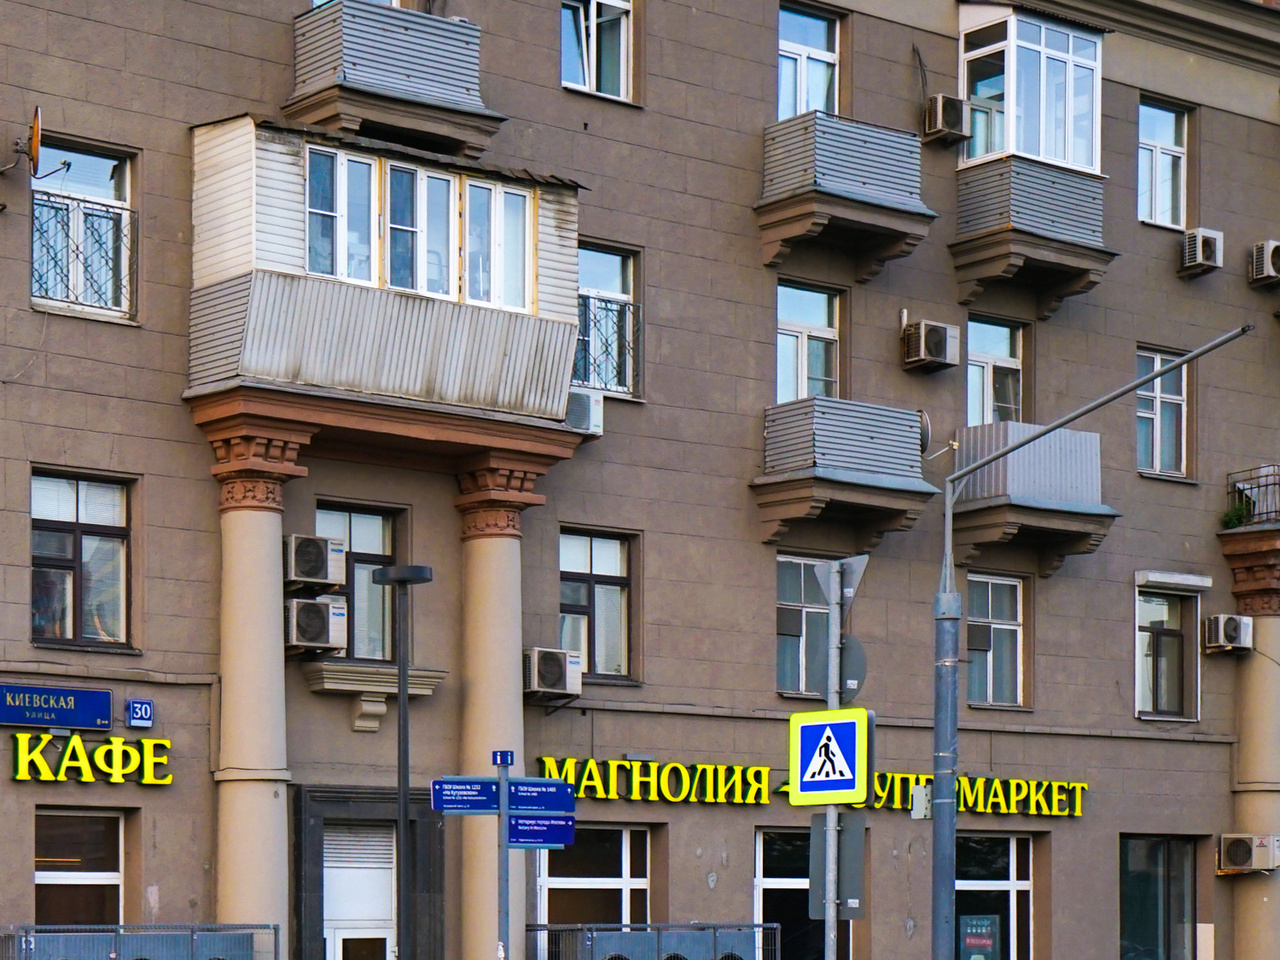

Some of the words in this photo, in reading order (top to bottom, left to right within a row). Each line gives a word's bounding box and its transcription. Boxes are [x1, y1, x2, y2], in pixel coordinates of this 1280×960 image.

[6, 692, 75, 710] КИЕВСКАЯ
[25, 711, 56, 720] УЛИЦА
[133, 703, 151, 719] 30
[14, 732, 174, 786] КАФЕ
[542, 756, 771, 805] МАГНОЛИЯ
[851, 772, 1089, 817] УПМАРКЕТ
